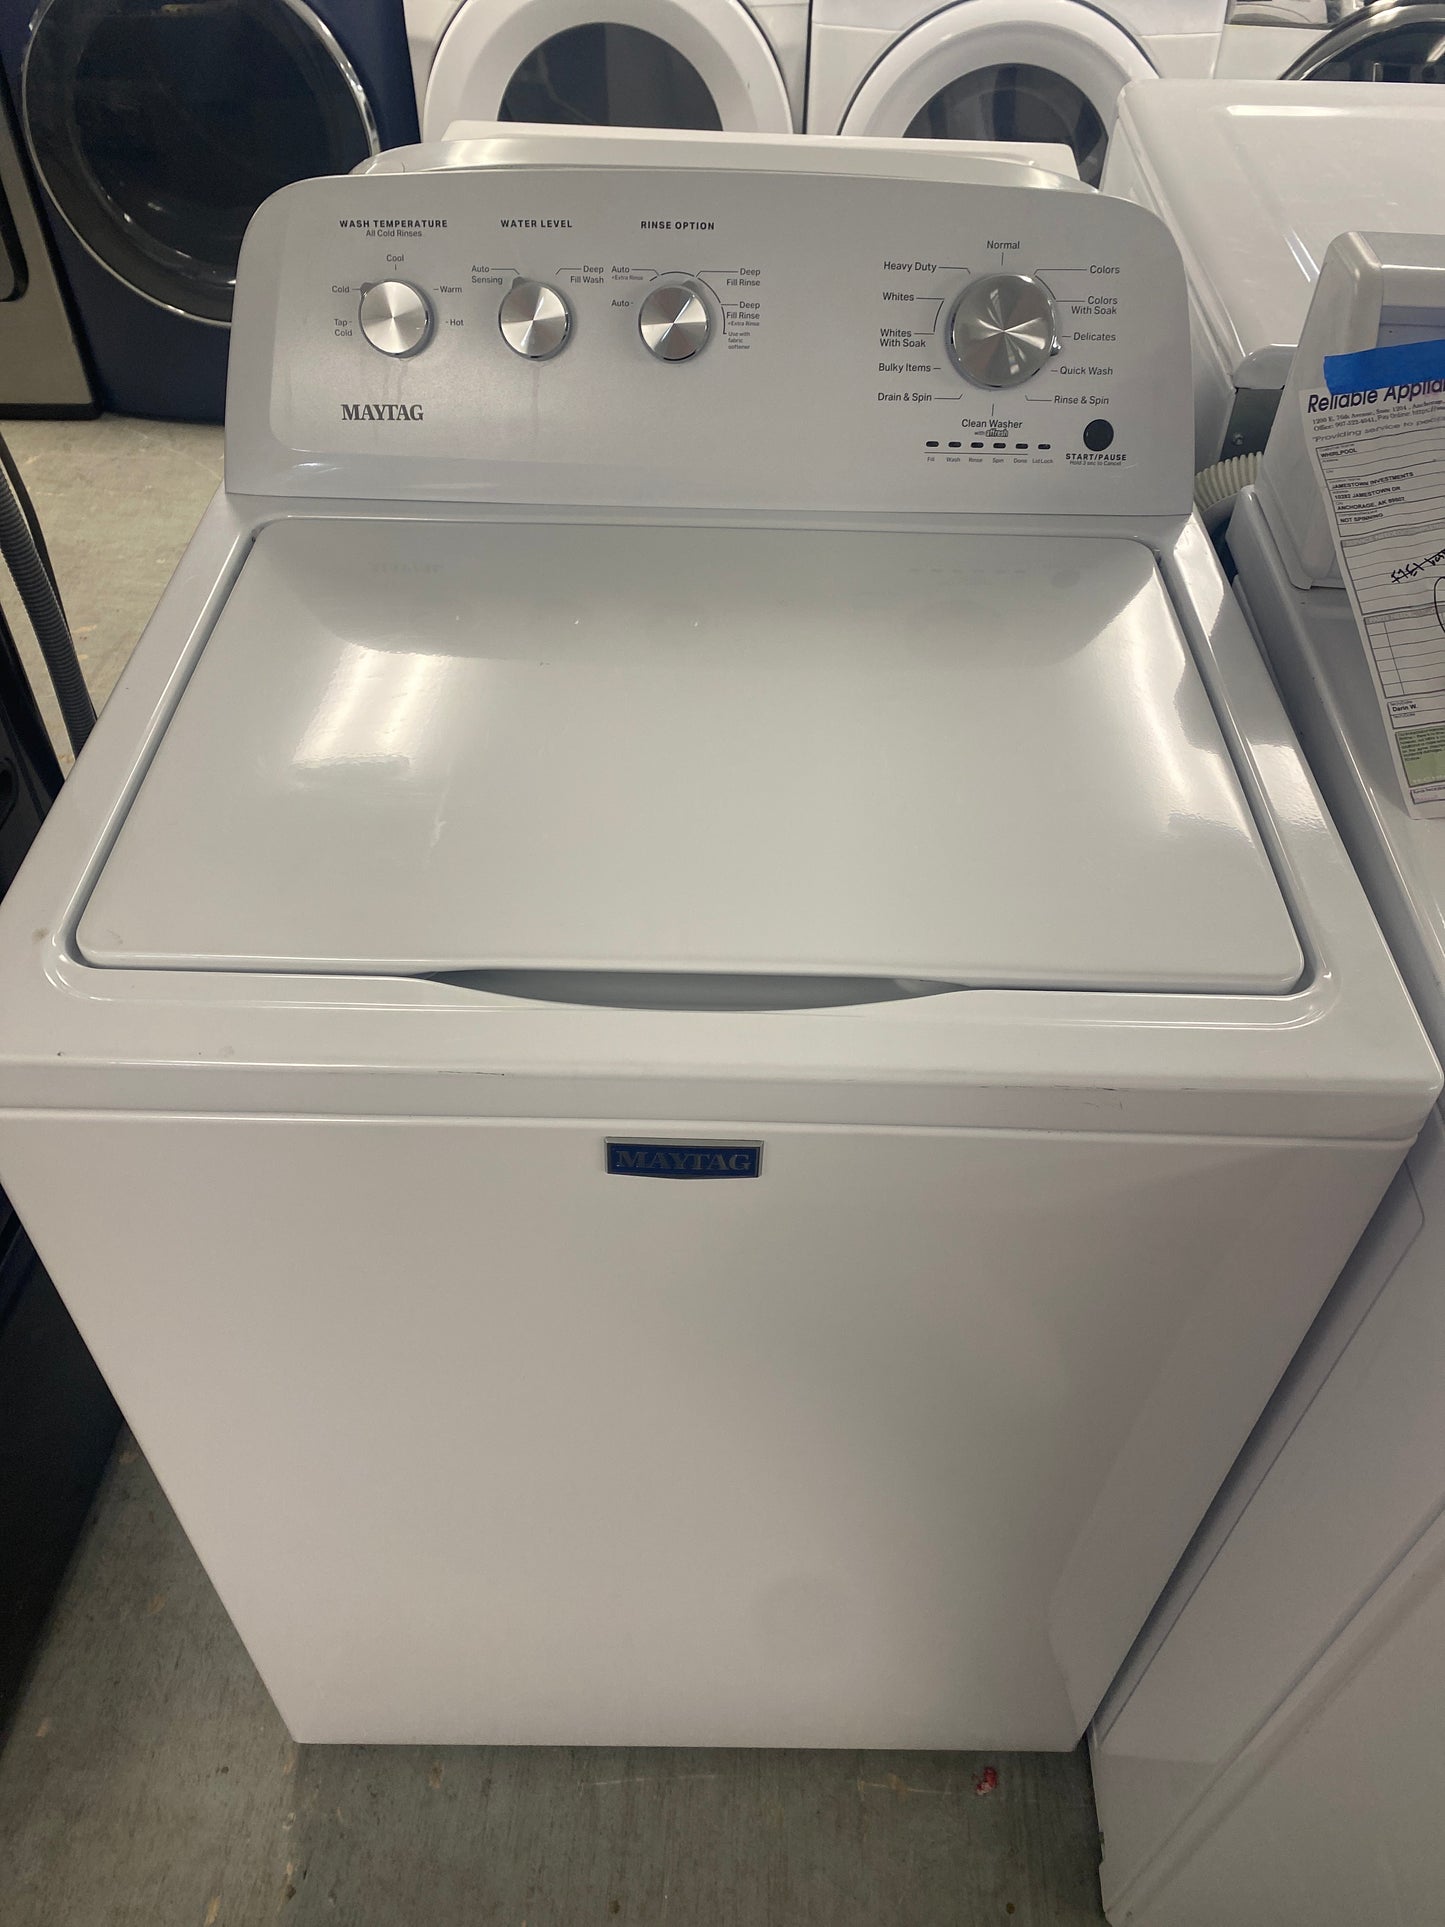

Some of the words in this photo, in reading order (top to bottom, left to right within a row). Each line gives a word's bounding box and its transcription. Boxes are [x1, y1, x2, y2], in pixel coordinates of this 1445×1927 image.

[340, 220, 369, 228] WASH
[374, 220, 447, 228] TEMPERATURE
[501, 220, 537, 228] WATER
[541, 220, 573, 228] LEVEL
[641, 221, 672, 230] RINSE
[675, 221, 715, 230] OPTION
[987, 240, 1020, 249] Normal
[583, 266, 604, 274] Deep
[740, 268, 760, 276] Deep
[883, 262, 912, 272] Heavy
[915, 262, 937, 273] Duty
[1090, 265, 1120, 274] Colors
[472, 276, 503, 285] Sensing
[570, 276, 581, 284] Fill
[582, 276, 604, 284] Wash
[883, 292, 914, 301] Whites
[1088, 296, 1118, 305] Colors
[740, 301, 760, 310] Deep
[1071, 306, 1092, 315] With
[1094, 306, 1117, 315] Soak
[334, 319, 348, 328] Tap
[880, 329, 912, 337] Whites
[1074, 332, 1116, 341] Delicates
[880, 339, 901, 347] With
[903, 339, 926, 348] Soak
[878, 363, 903, 373] Bulky
[906, 364, 931, 372] Items
[1060, 366, 1087, 376] Quick
[1089, 367, 1113, 375] Wash
[878, 393, 902, 401] Drain
[904, 393, 910, 401] &
[912, 393, 932, 403] Spin
[1054, 396, 1078, 404] Rinse
[1080, 396, 1087, 405] &
[1089, 396, 1109, 406] Spin
[1308, 390, 1378, 413] Reliable
[341, 404, 424, 421] MAYTAG
[962, 419, 986, 428] Clean
[989, 419, 1022, 429] Washer
[616, 1151, 751, 1170] MAYTAG
